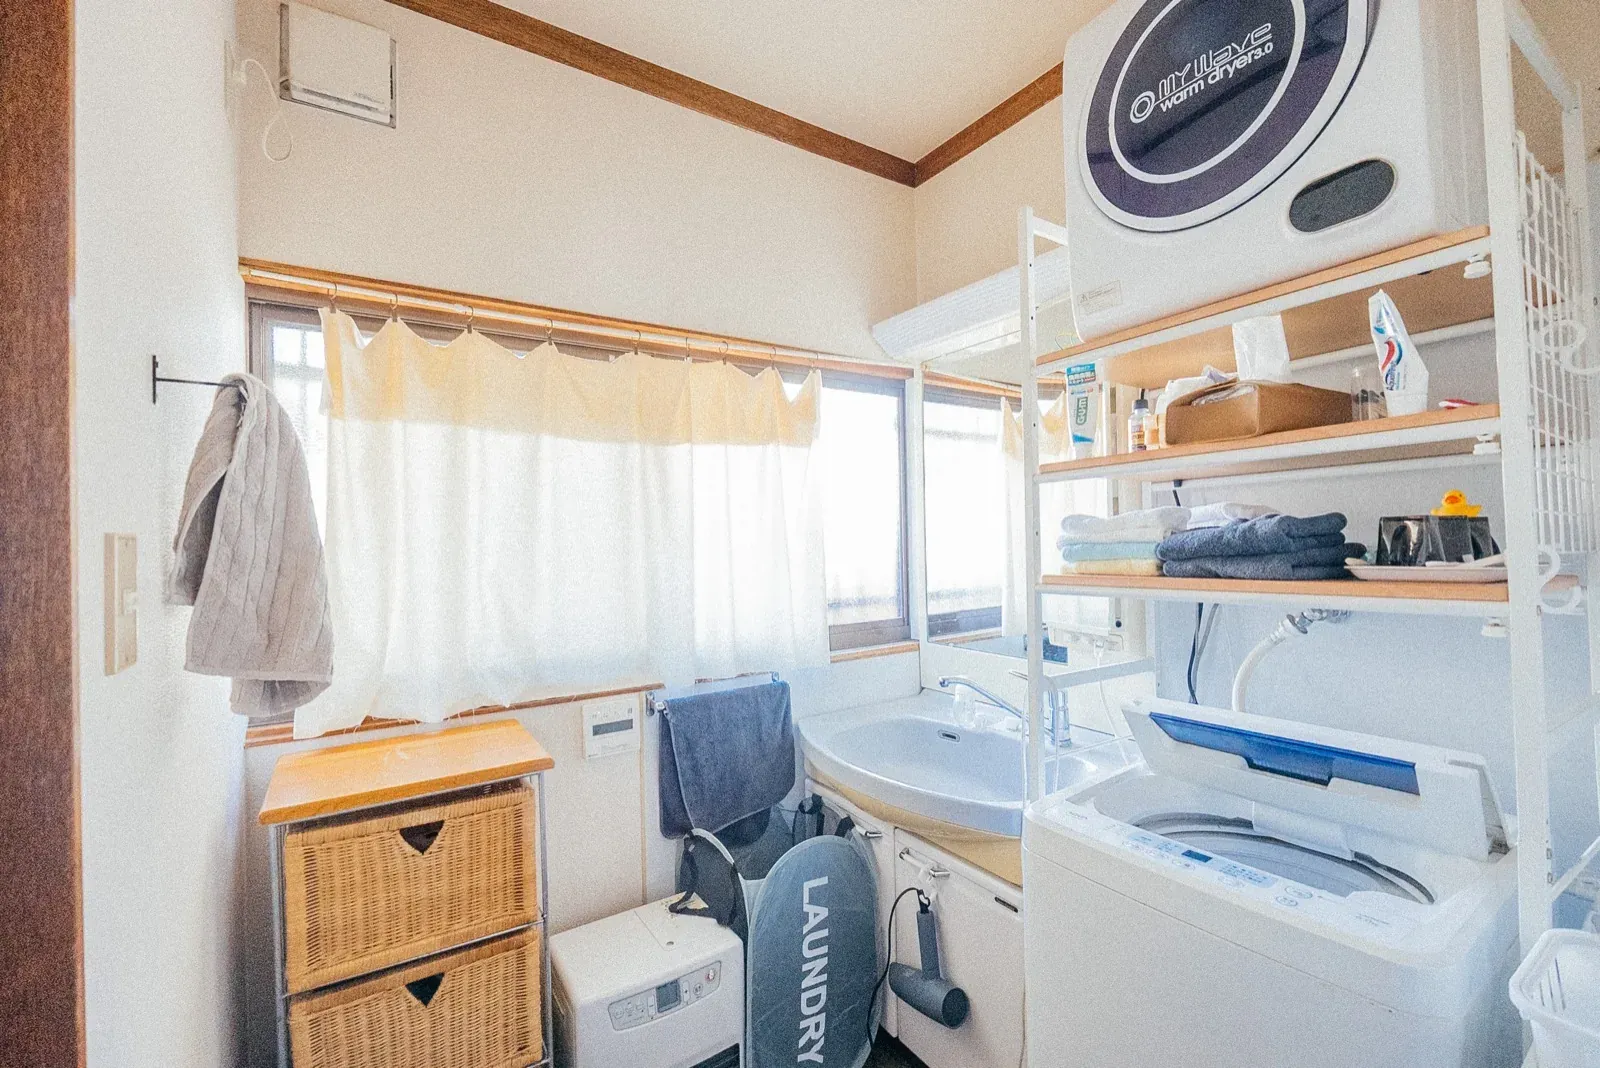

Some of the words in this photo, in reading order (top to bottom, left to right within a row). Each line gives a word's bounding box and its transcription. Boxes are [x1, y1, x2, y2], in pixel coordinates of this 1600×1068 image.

[1159, 79, 1205, 112] warm
[1077, 397, 1087, 424] GUM
[797, 876, 829, 1064] LAUNDRY
